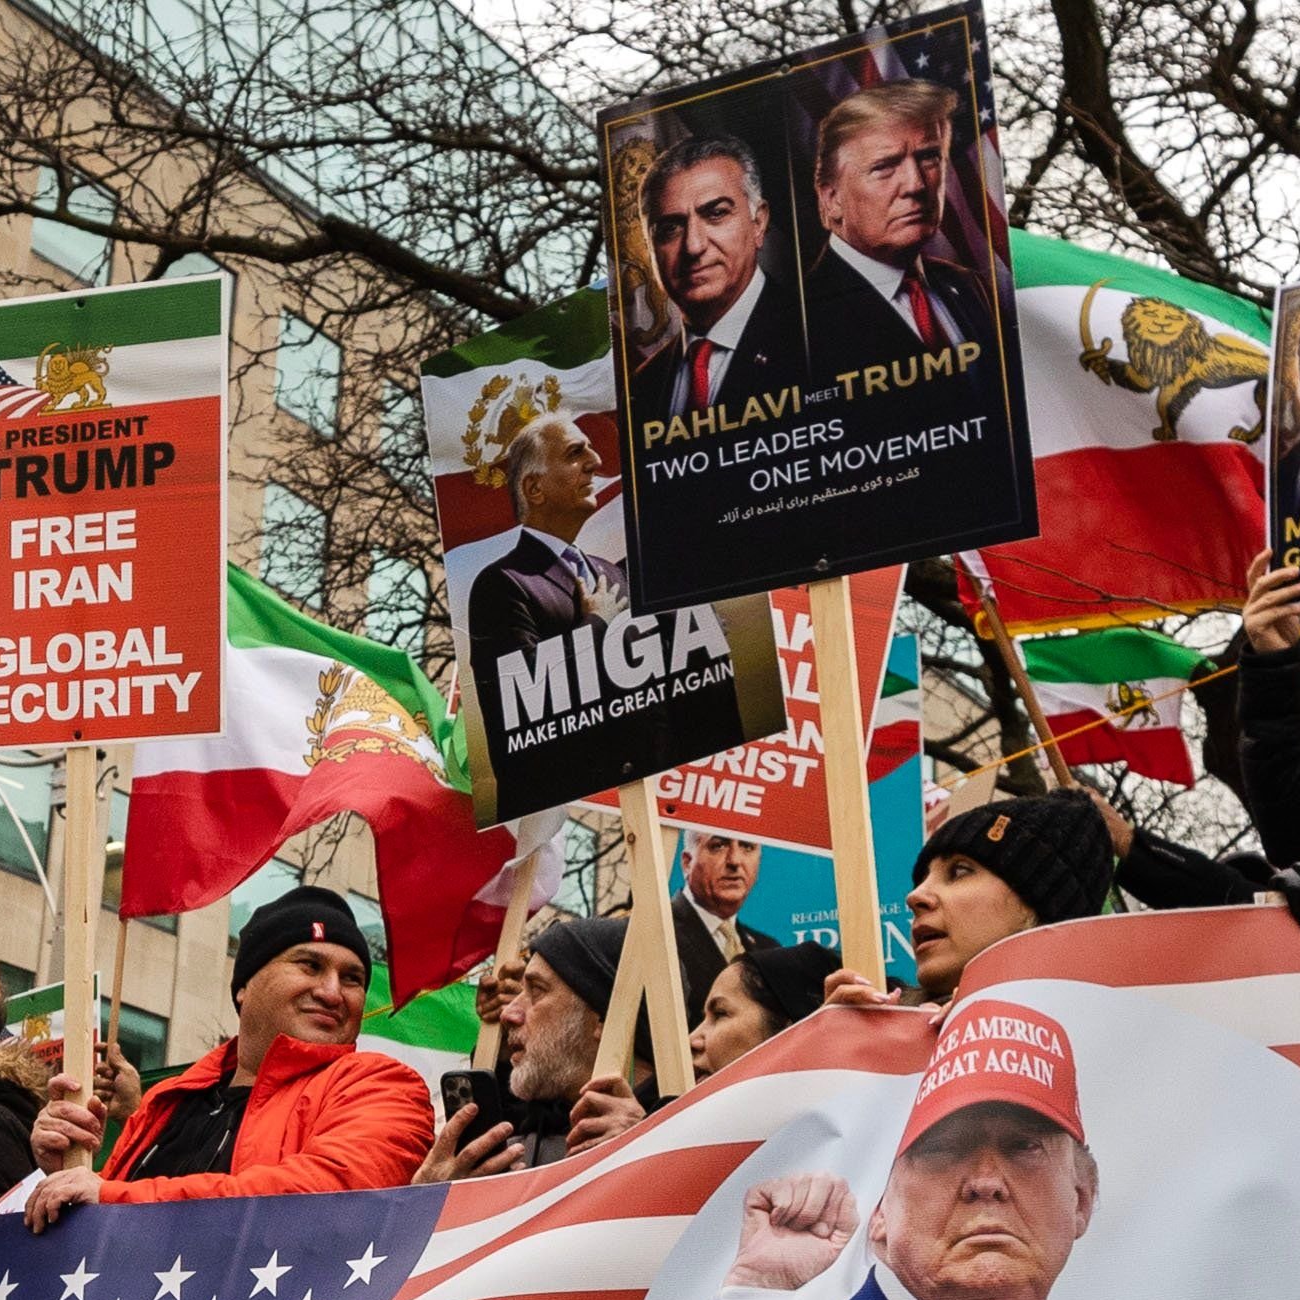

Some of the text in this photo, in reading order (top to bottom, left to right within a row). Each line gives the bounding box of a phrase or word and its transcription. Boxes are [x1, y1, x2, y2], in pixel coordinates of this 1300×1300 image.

[643, 341, 981, 449] PAHLAVI MEET TRUMP
[5, 415, 149, 450] PRESIDENT
[645, 419, 845, 484] TWO LEADERS
[750, 416, 987, 492] ONE MOVEMENT
[10, 510, 137, 559] FREE
[13, 561, 133, 611] IRAN
[496, 603, 731, 731] MIGA
[507, 660, 734, 753] MAKE IRAN GREAT AGAIN
[655, 770, 766, 817] GIME
[961, 1016, 1065, 1059] AMERICA
[916, 1048, 1055, 1105] GREAT AGAIN
